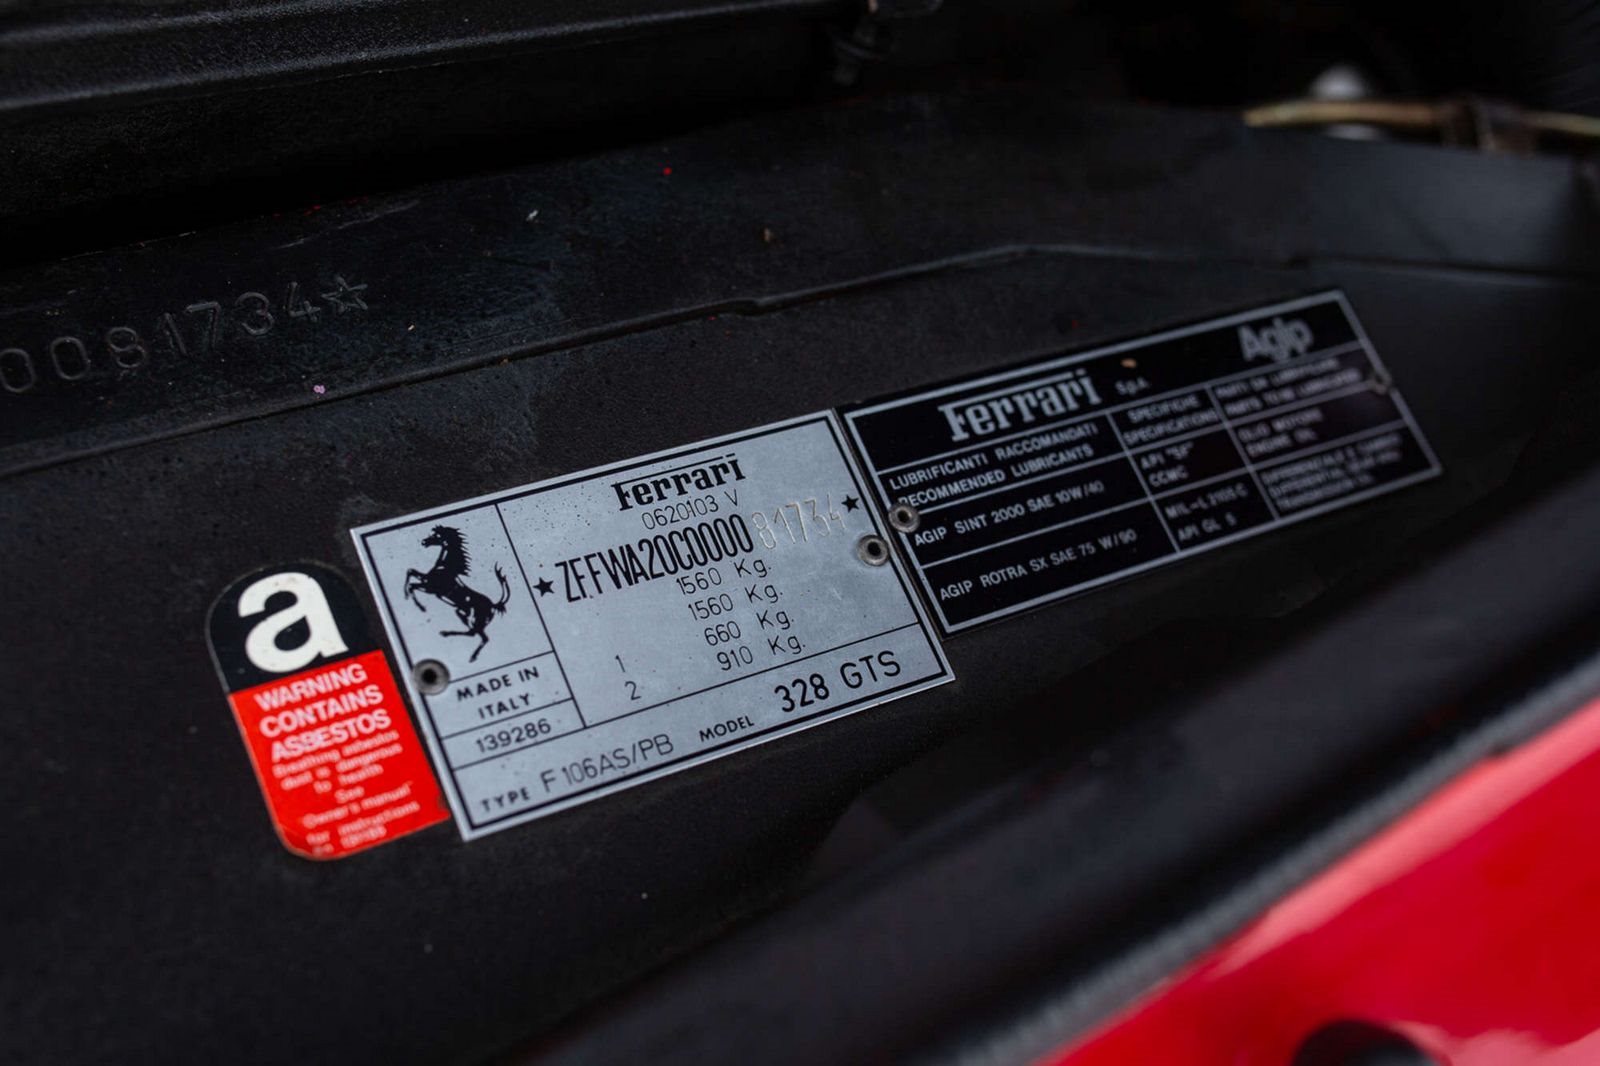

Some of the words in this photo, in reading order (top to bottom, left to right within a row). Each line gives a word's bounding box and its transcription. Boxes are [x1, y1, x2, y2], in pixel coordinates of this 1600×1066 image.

[938, 369, 1102, 442] Ferrari
[611, 453, 746, 511] Ferrari
[889, 453, 988, 490] LUBRIFICANTI
[994, 422, 1098, 461] RACCOMANDATI
[1010, 444, 1094, 478] LUBRICANTS
[641, 495, 719, 530] 0620103
[724, 489, 738, 506] V
[913, 526, 948, 547] AGIP
[954, 514, 988, 535] SINT
[991, 501, 1025, 524] 2000
[1027, 493, 1056, 514] SAE
[676, 567, 722, 595] 1560
[734, 558, 771, 578] Kg.
[939, 579, 974, 601] AGIP
[980, 564, 1028, 588] ROTRA
[1030, 556, 1048, 572] SX
[1049, 548, 1077, 566] SAE
[1078, 538, 1096, 556] 75
[238, 572, 349, 673] a
[688, 593, 734, 621] 1560
[744, 584, 784, 604] Kg.
[615, 654, 626, 673] 1
[704, 620, 741, 646] 660
[756, 610, 794, 630] Kg.
[253, 664, 368, 711] WARNING
[456, 674, 512, 701] MADE
[518, 666, 539, 682] IN
[624, 681, 642, 701] 2
[717, 646, 753, 671] 910
[767, 635, 806, 655] Kg.
[259, 684, 384, 737] CONTAINS
[478, 693, 531, 719] ITALY
[699, 716, 754, 742] MODEL
[774, 674, 829, 712] 328
[840, 650, 900, 688] GTS
[271, 709, 392, 761] ASBESTOS
[475, 718, 551, 752] 139286
[481, 787, 530, 813] TYPE
